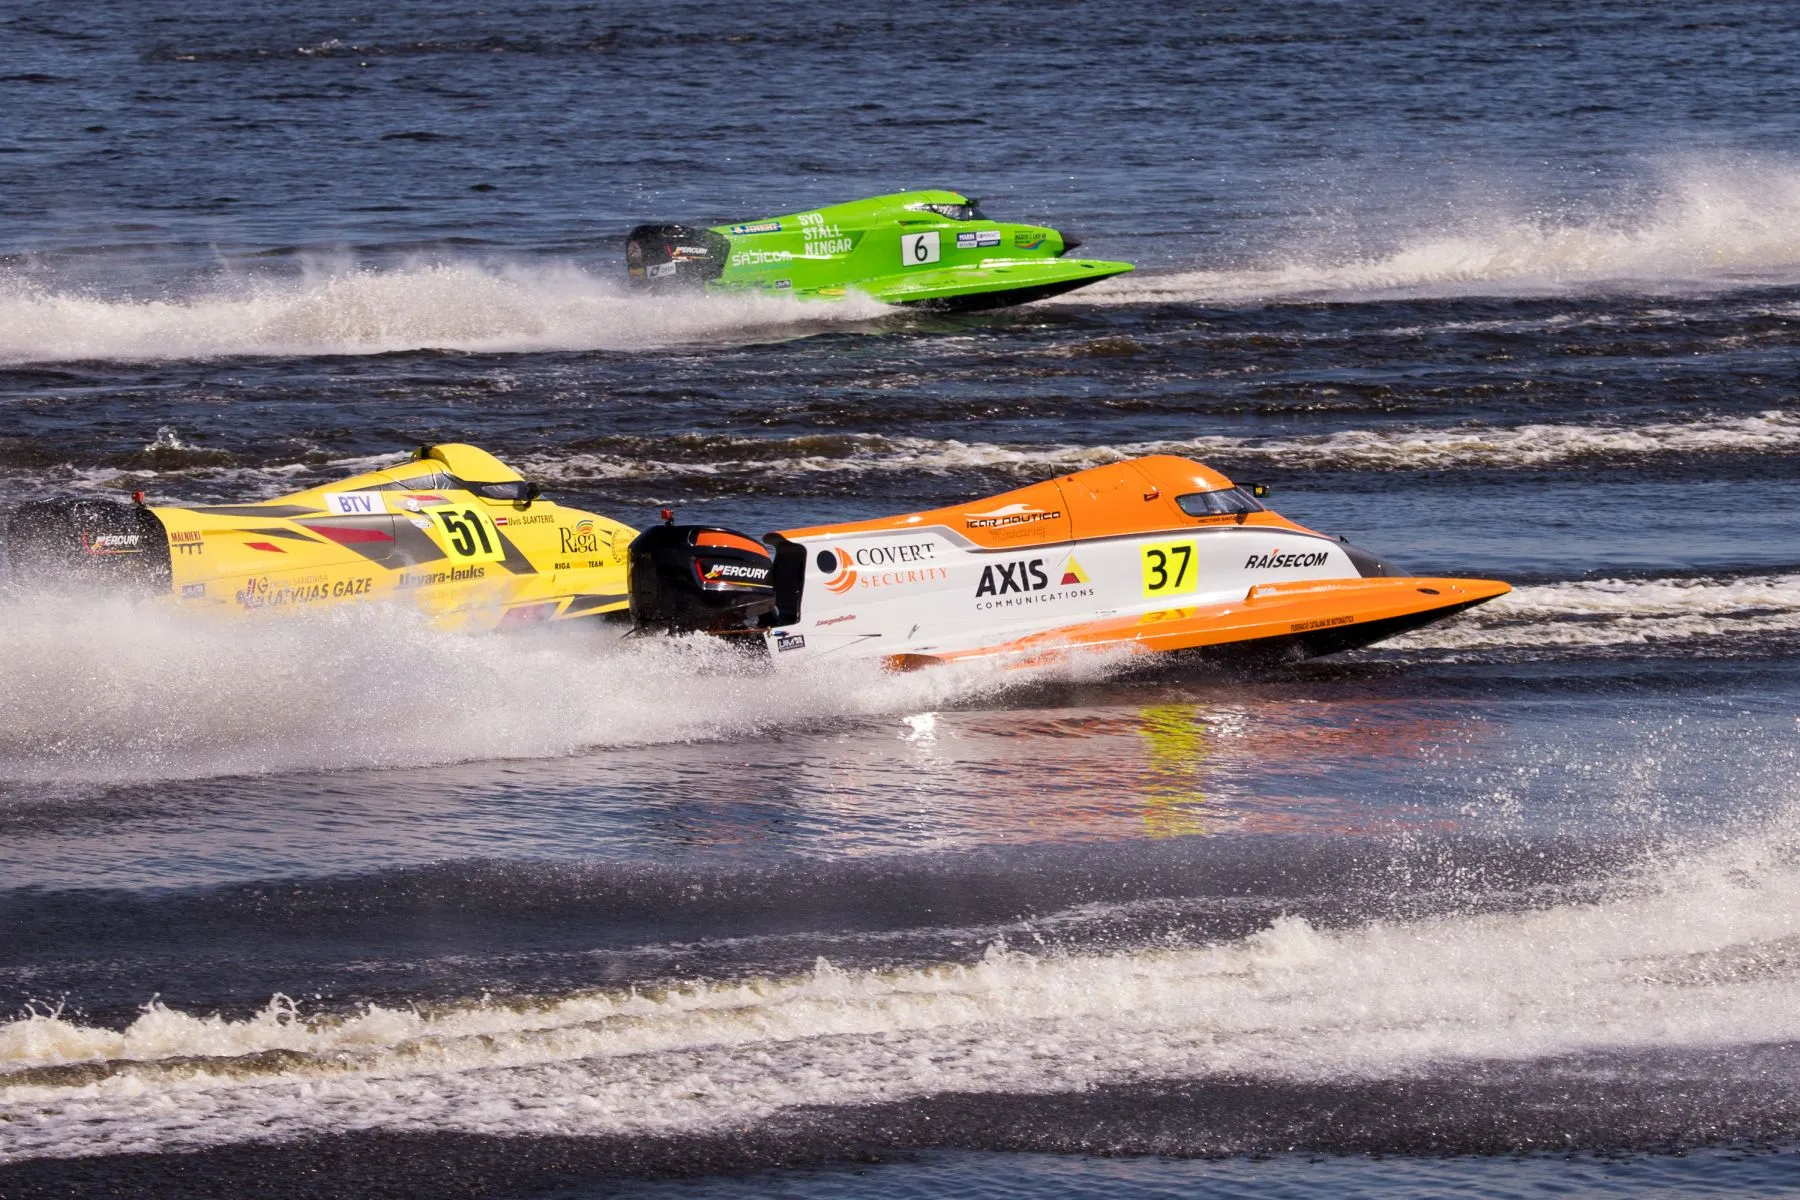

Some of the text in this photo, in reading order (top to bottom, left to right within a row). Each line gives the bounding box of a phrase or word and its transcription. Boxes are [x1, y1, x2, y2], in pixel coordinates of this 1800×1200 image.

[797, 213, 824, 226] SYD
[675, 246, 708, 255] MERCURY
[804, 238, 853, 256] NINGAR
[914, 235, 928, 262] 6
[337, 495, 371, 513] BTV
[95, 534, 140, 546] MERCURY
[437, 509, 494, 557] 51
[856, 543, 935, 566] COVERT
[1244, 549, 1329, 569] RAISECOM
[554, 562, 571, 570] RIGA
[588, 560, 604, 568] TEAM
[711, 563, 769, 580] MERCURY
[1146, 546, 1192, 591] 37
[860, 566, 949, 589] SECURITY
[975, 558, 1049, 598] AXIS
[975, 588, 1095, 611] COMMUNICATIONS
